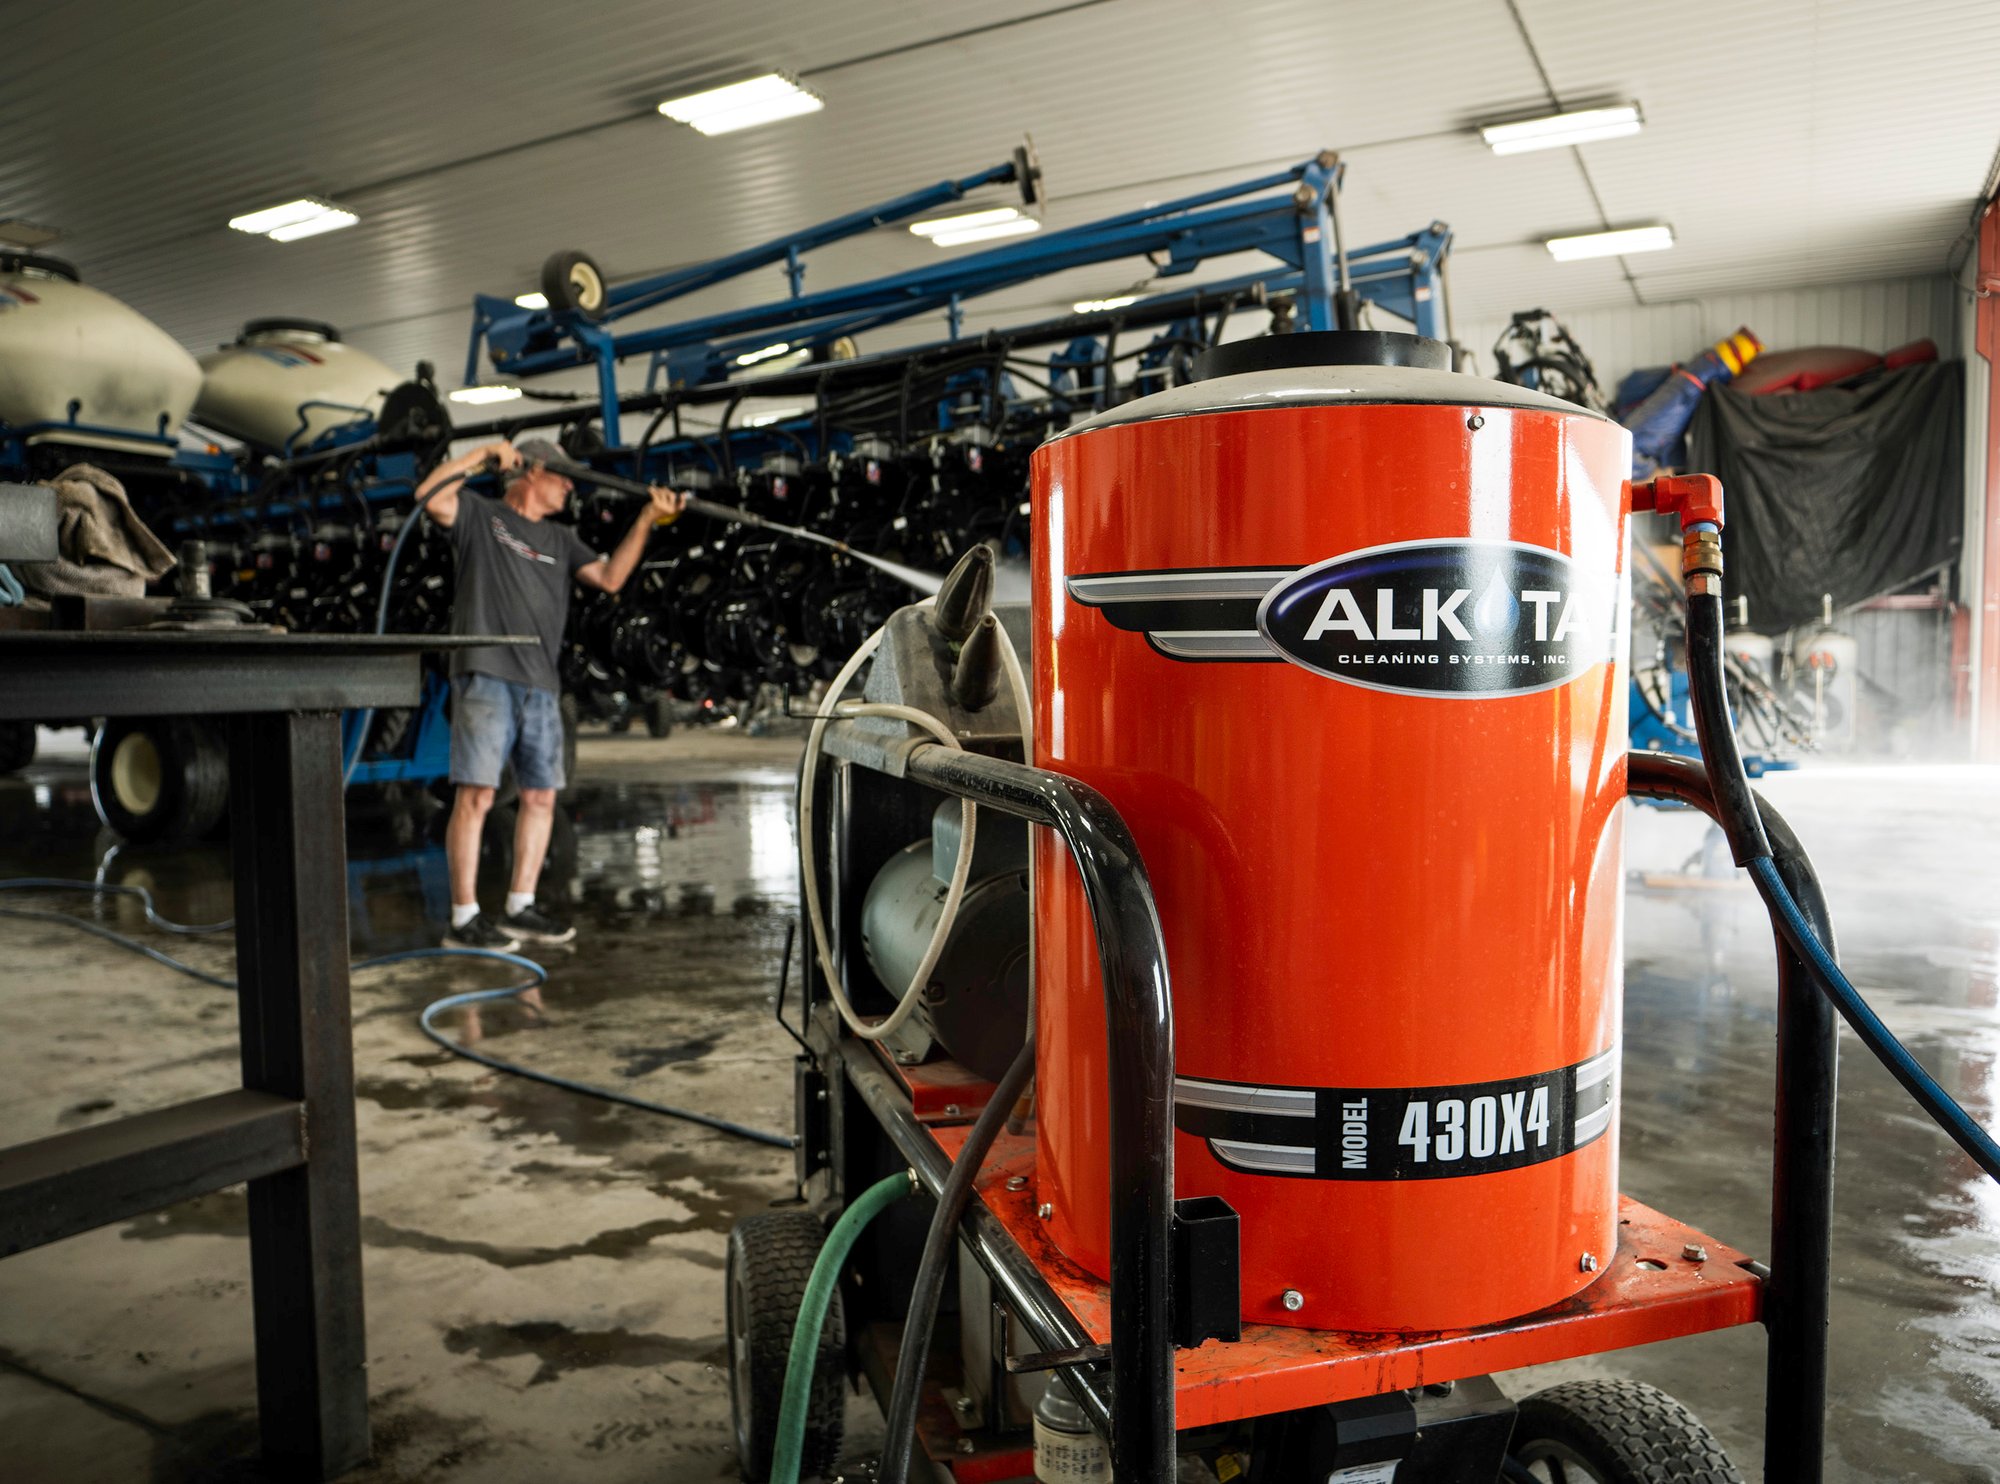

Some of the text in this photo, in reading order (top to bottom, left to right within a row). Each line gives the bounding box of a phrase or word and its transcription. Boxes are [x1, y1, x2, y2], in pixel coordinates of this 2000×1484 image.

[1338, 654, 1571, 666] CLEANING SYSTEMS, INC.
[1342, 1097, 1368, 1170] MODEL
[1398, 1085, 1550, 1163] 430X4
